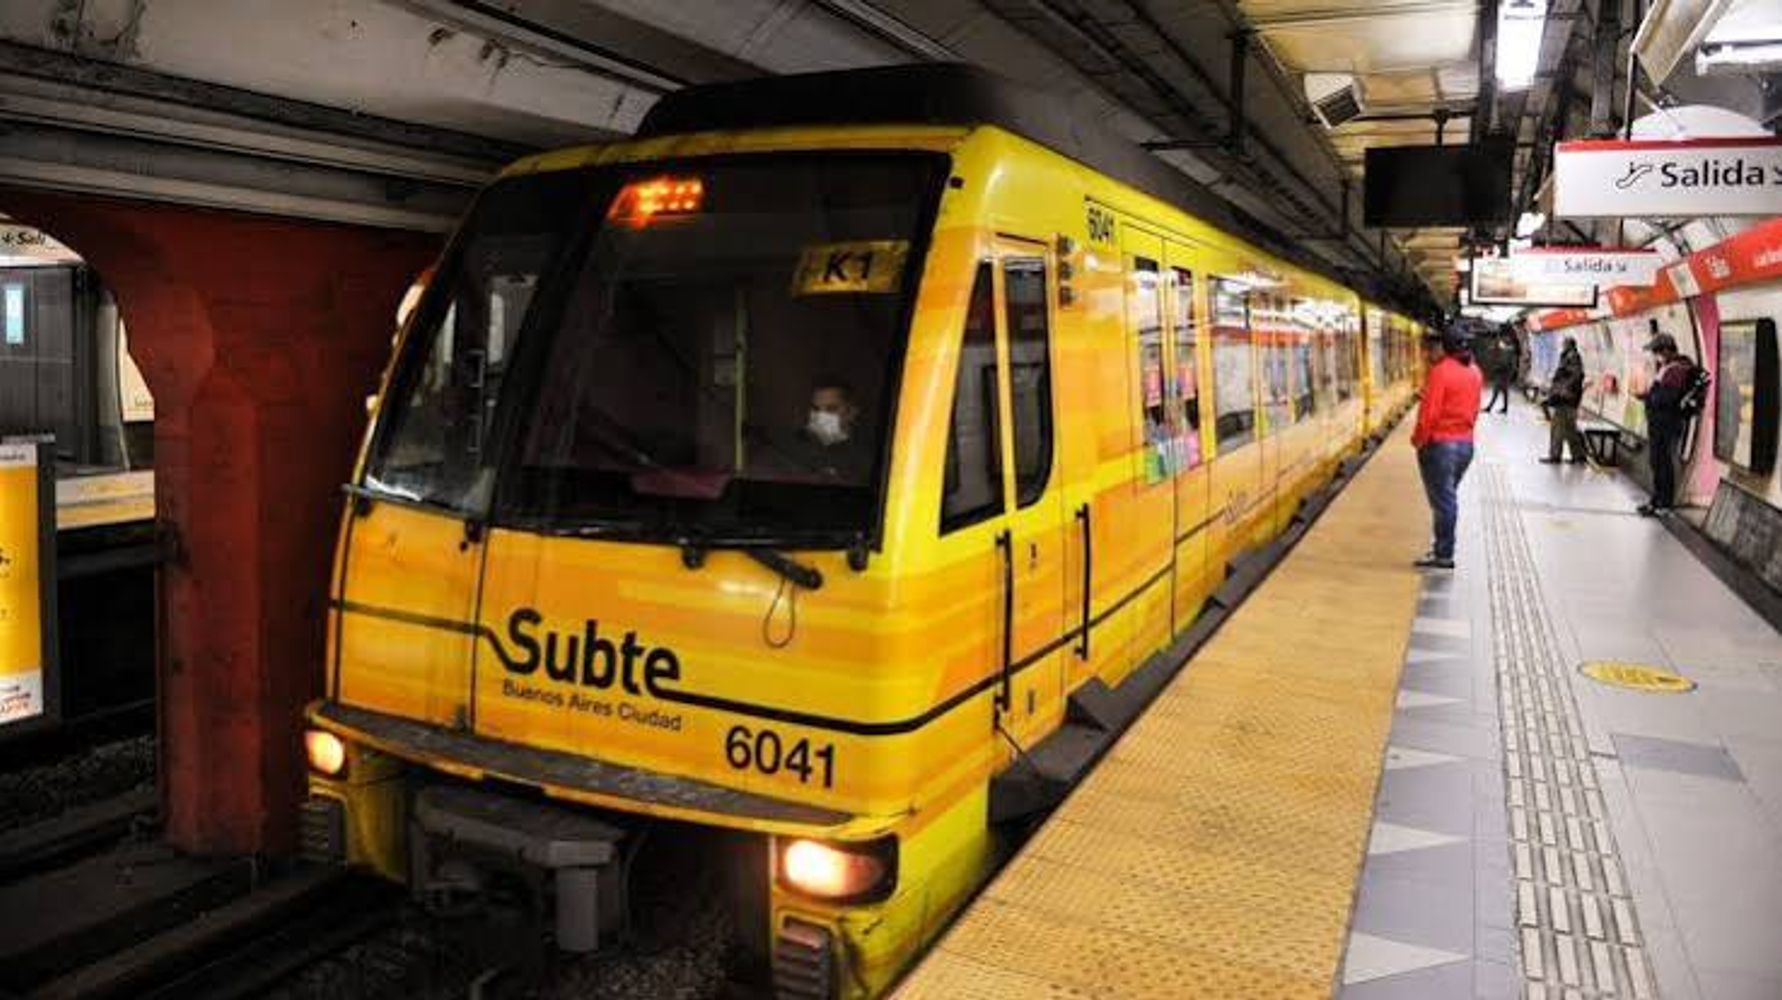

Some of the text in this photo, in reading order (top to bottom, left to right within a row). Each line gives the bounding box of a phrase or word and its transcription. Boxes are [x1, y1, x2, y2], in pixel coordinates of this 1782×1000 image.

[1660, 159, 1764, 188] Salida
[823, 251, 875, 284] K1
[1564, 257, 1612, 273] Salida
[508, 607, 681, 700] Subte
[502, 678, 682, 732] Buenos Aires Ciudad
[725, 725, 837, 789] 6041
